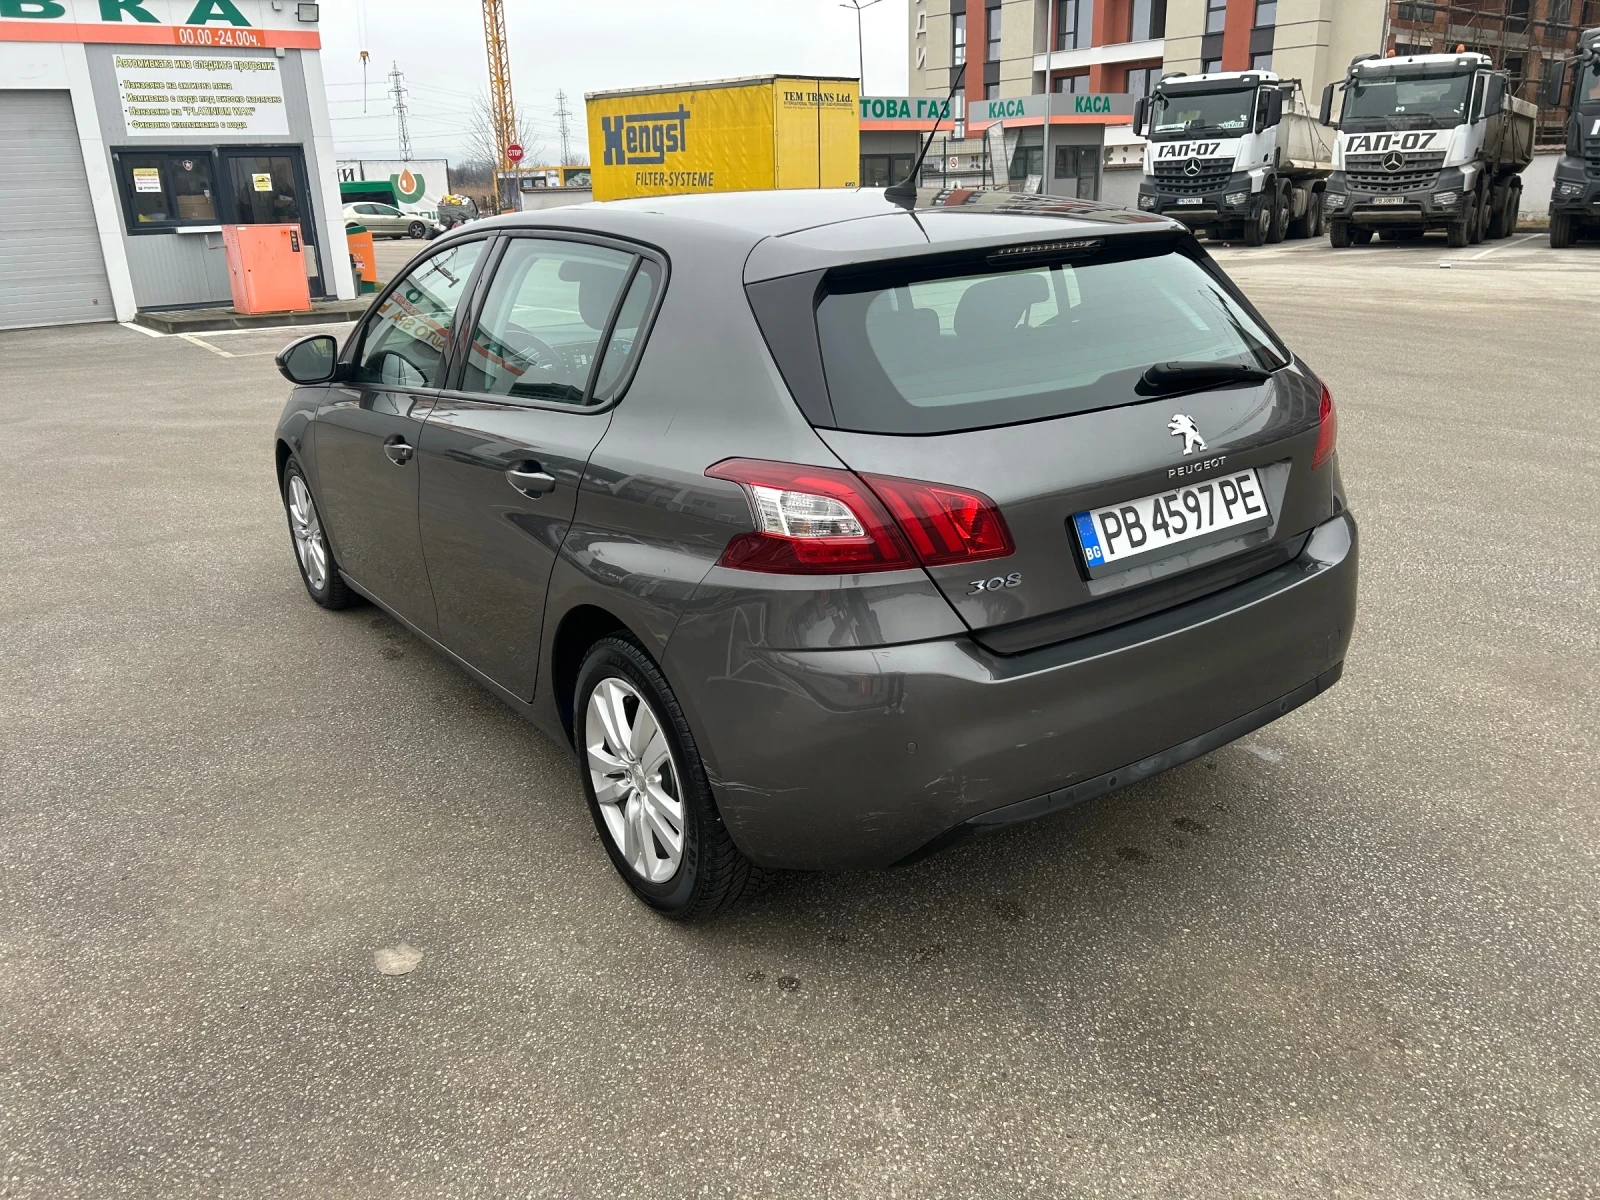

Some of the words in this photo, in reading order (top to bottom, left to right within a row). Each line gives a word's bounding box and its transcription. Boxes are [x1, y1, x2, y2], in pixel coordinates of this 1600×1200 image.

[179, 28, 212, 44] 00.00
[116, 56, 174, 69] Автомивката
[174, 60, 192, 69] има
[193, 60, 232, 71] следните
[784, 92, 803, 101] TEM
[806, 93, 835, 102] TRANS
[836, 93, 853, 103] Ltd.
[1075, 96, 1111, 113] КАСА
[917, 100, 950, 118] ГАЗ
[988, 99, 1025, 118] КАСА
[602, 104, 690, 165] Hengst
[1345, 132, 1437, 152] ГАП-07
[508, 149, 522, 157] STOP
[1158, 142, 1221, 158] ГАП-07
[635, 171, 714, 187] FILTER-SYSTEME
[1167, 455, 1227, 479] PEUGEOT
[1098, 505, 1147, 555] PB
[1153, 486, 1214, 538] 4597
[1218, 474, 1262, 520] PE
[1085, 544, 1101, 561] BG
[965, 571, 1022, 596] 308
